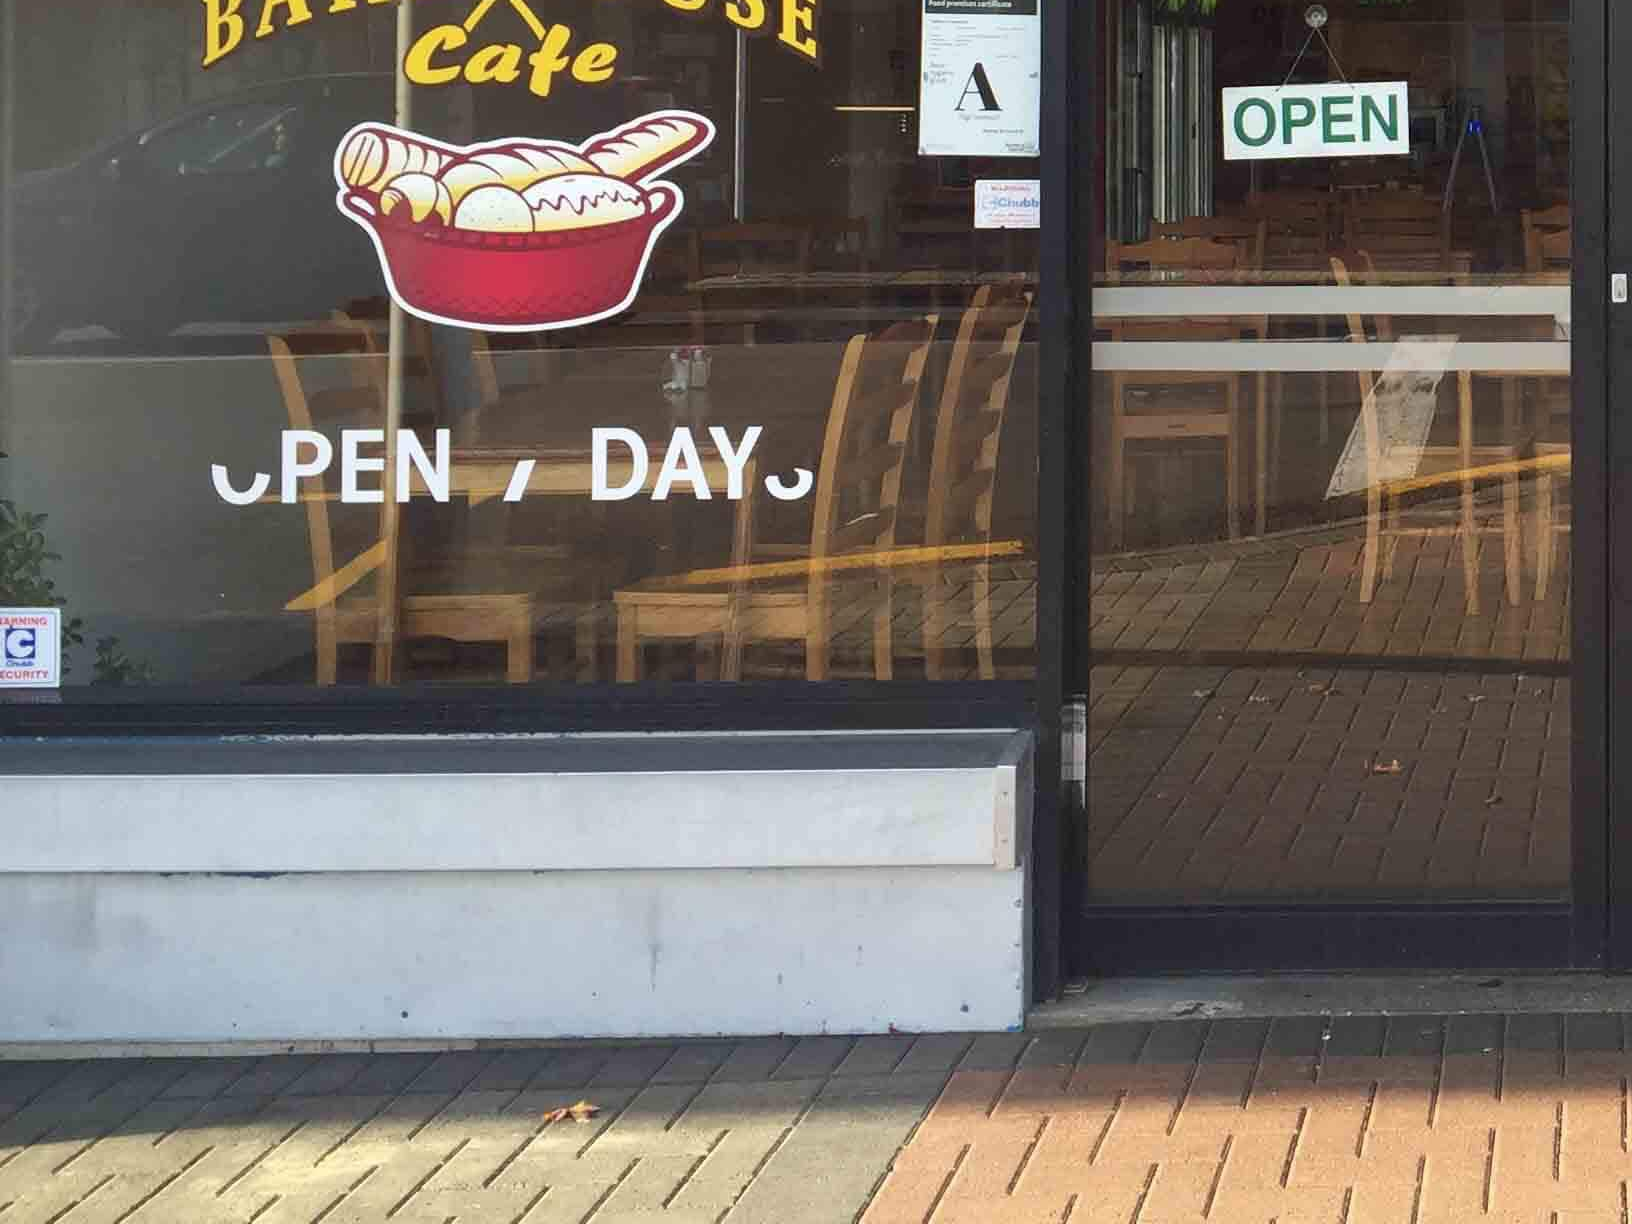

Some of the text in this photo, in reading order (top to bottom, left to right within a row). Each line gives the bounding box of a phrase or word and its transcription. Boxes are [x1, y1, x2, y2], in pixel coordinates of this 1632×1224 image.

[403, 23, 619, 98] Cafe
[954, 62, 1003, 112] A
[1233, 93, 1399, 147] OPEN
[0, 617, 48, 626] ARNING
[0, 670, 49, 680] ECURITY
